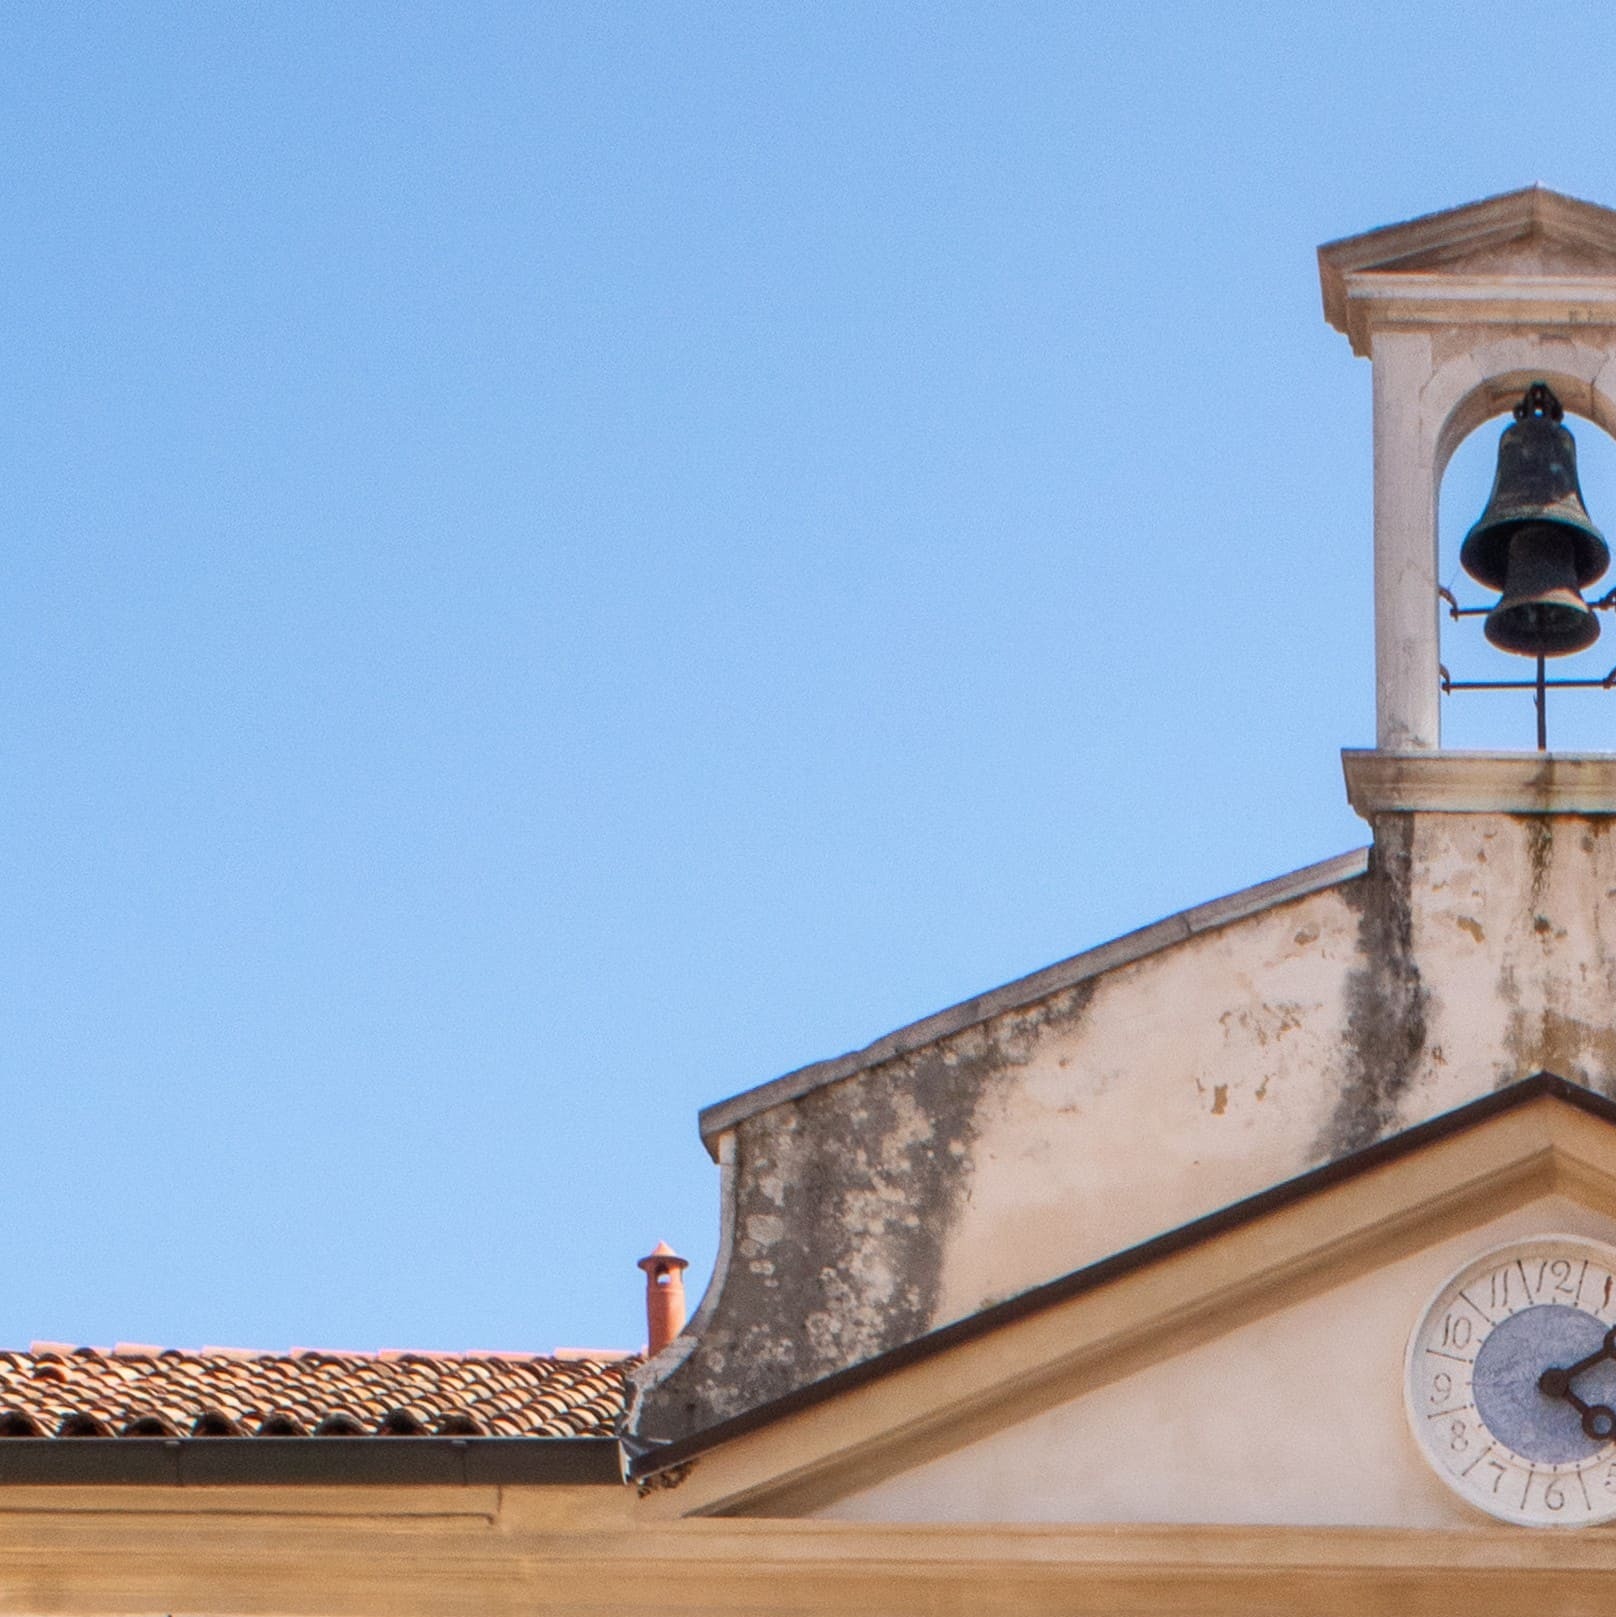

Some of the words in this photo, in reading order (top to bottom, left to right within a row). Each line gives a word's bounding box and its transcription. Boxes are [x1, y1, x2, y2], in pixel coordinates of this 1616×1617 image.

[1489, 1269, 1509, 1308] 11
[1535, 1259, 1576, 1294] 12
[1602, 1275, 1612, 1309] 1
[1441, 1313, 1473, 1347] 10
[1430, 1373, 1453, 1405] 9
[1450, 1420, 1469, 1451] 8
[1488, 1460, 1508, 1493] 7
[1544, 1478, 1566, 1511] 6
